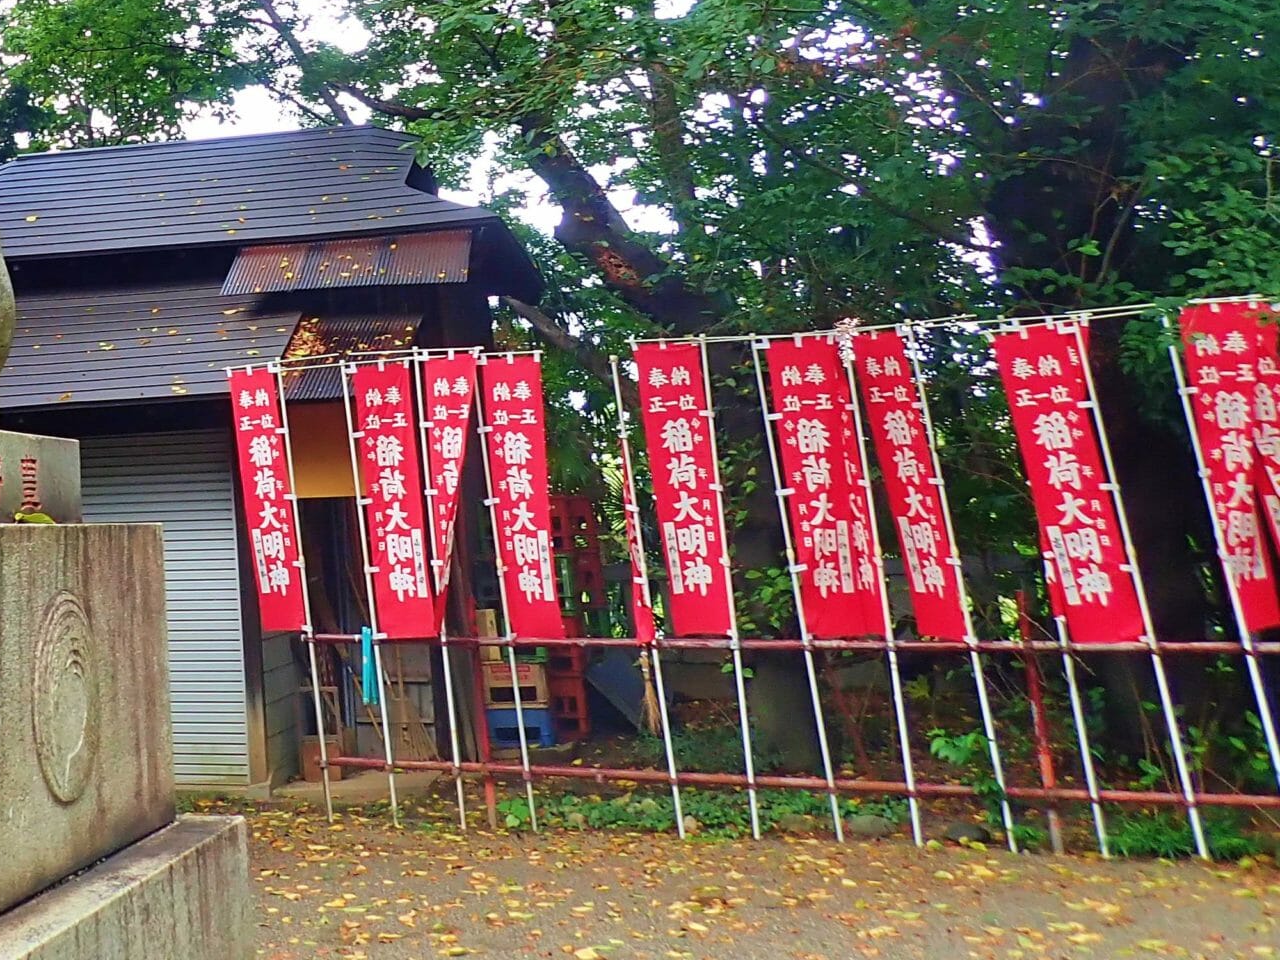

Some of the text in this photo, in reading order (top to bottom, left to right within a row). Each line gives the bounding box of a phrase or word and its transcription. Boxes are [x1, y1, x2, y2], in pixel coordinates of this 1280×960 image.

[648, 365, 691, 389] 奉納
[865, 355, 902, 378] 奉納
[1011, 354, 1063, 380] 奉納
[238, 388, 270, 409] 奉納
[648, 393, 697, 413] 正一位
[869, 385, 910, 403] 正一位
[1015, 384, 1073, 407] 正一位
[239, 414, 275, 431] 正一位
[660, 417, 713, 597] 稲荷大明神
[883, 409, 946, 599] 稲荷大明神
[1032, 411, 1113, 608] 稲荷大明神
[248, 435, 290, 597] 稲荷大明神
